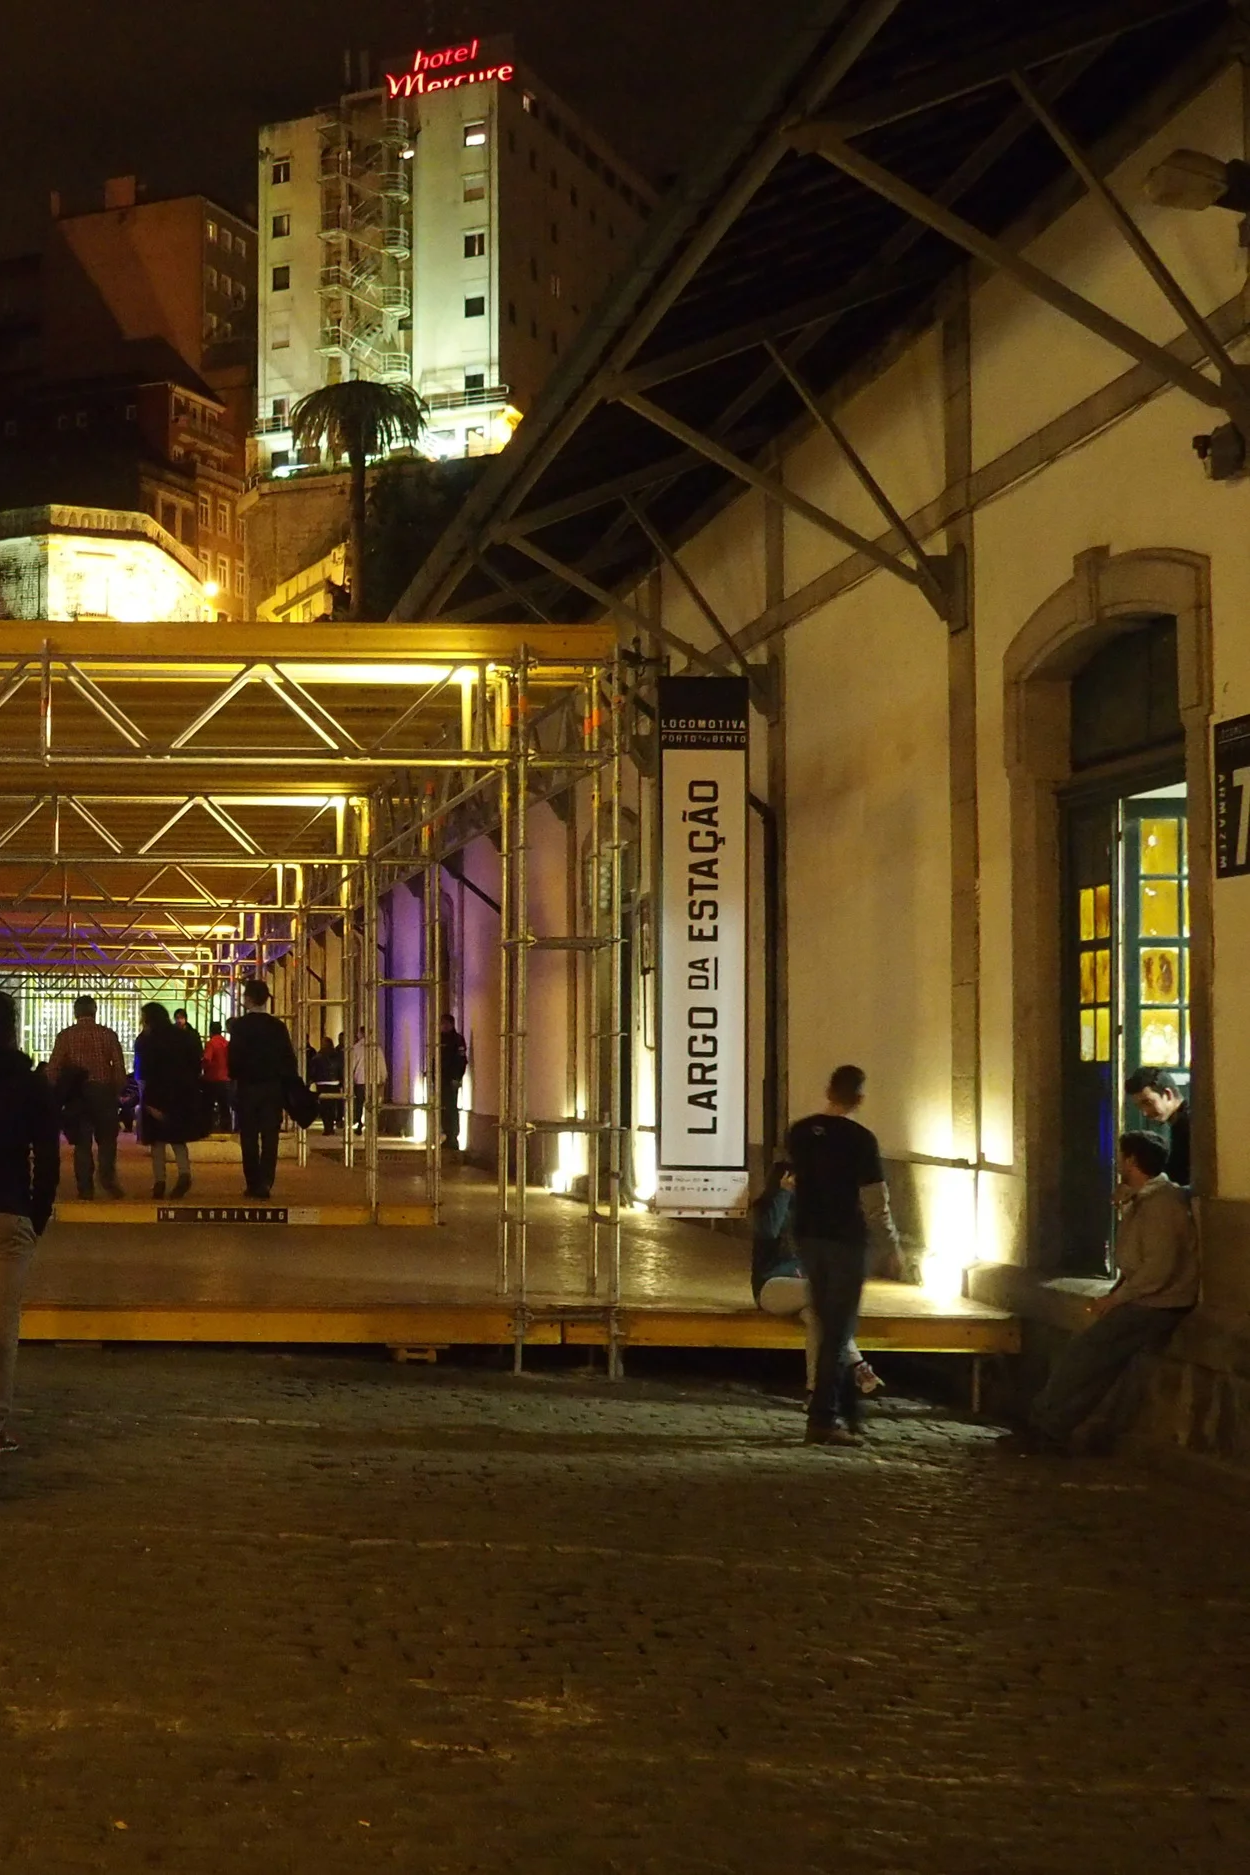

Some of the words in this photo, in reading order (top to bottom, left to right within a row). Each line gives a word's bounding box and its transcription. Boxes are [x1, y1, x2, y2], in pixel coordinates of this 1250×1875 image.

[414, 39, 479, 72] hotel
[385, 64, 514, 99] Mercure
[661, 719, 746, 730] LOCOMOTIVA
[661, 734, 697, 743] PORTO
[712, 735, 747, 744] BENTO
[682, 780, 725, 941] ESTAÇÃO
[687, 957, 712, 990] DA
[687, 1006, 718, 1134] LARGO
[197, 1210, 286, 1221] ARRIVING
